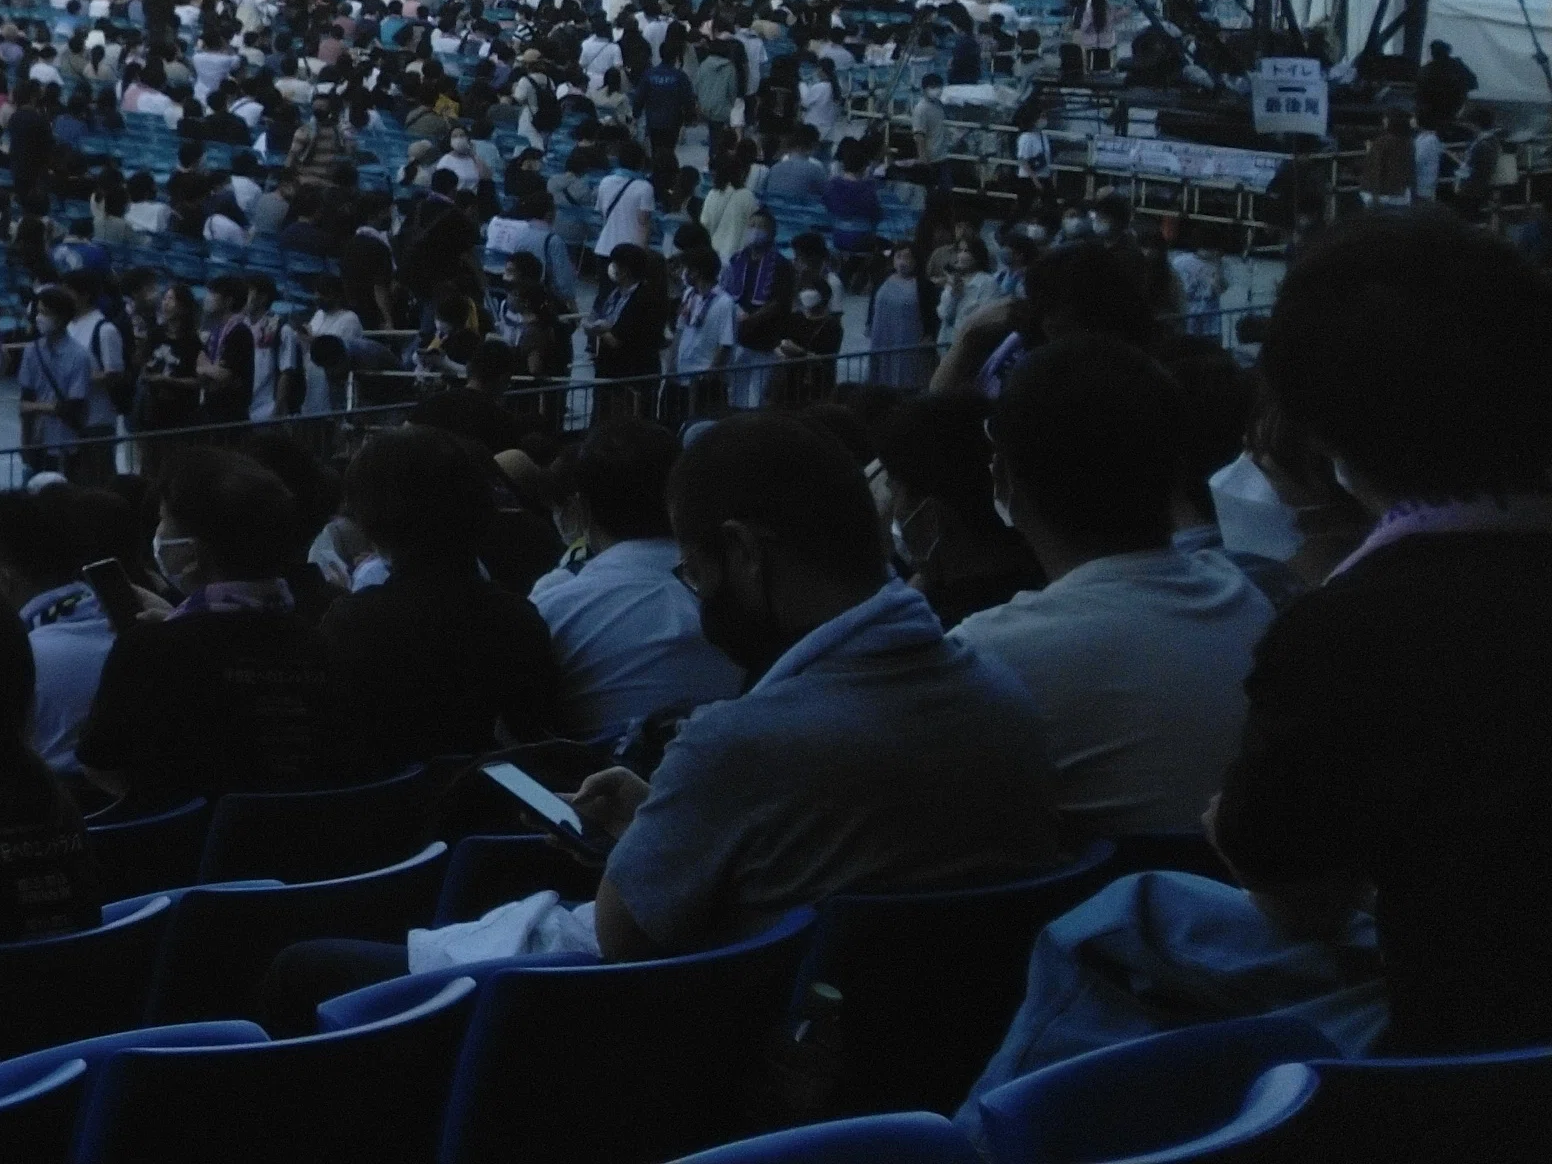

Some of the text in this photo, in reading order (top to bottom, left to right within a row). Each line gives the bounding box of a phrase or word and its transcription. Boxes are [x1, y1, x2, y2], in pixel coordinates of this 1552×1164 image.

[1273, 64, 1313, 76] トイレ
[1266, 97, 1320, 115] 最後尾
